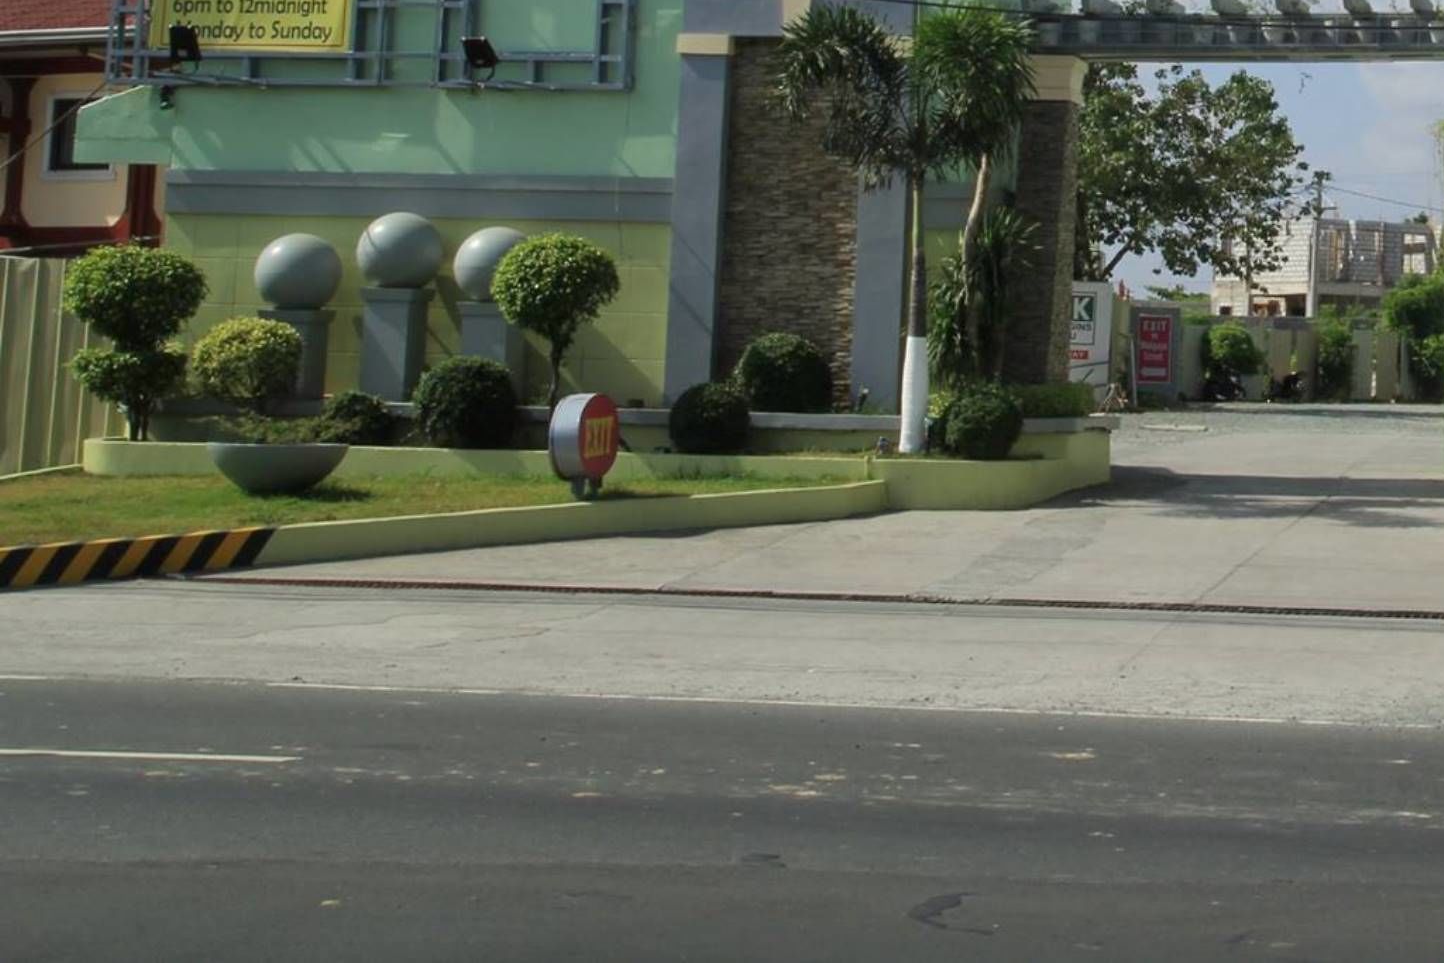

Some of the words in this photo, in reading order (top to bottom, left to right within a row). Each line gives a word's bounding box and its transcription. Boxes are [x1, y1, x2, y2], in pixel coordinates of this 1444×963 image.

[216, 0, 234, 14] to
[176, 21, 245, 42] onday
[248, 23, 266, 39] to
[271, 20, 333, 43] Sunday
[584, 415, 614, 459] EXIT
